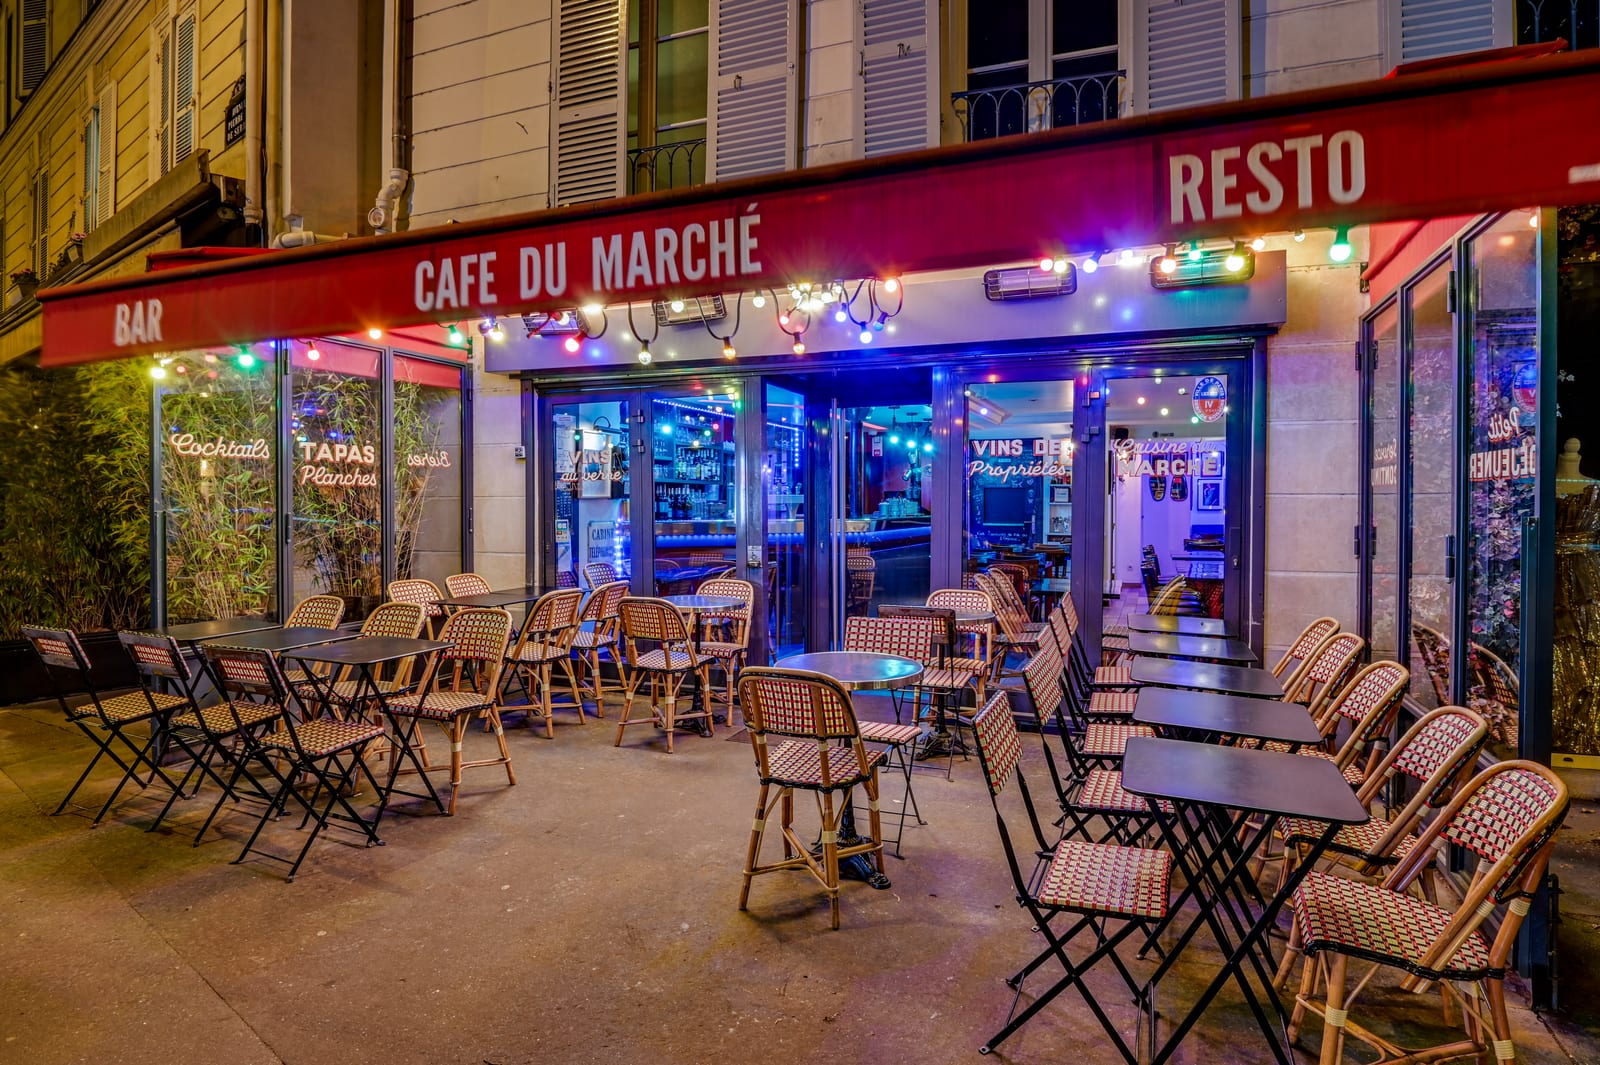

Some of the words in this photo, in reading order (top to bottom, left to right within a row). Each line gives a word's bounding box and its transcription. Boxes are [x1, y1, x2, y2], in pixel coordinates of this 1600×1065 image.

[1168, 129, 1367, 225] RESTO
[414, 251, 498, 312] CAFE
[520, 241, 567, 301] DU
[591, 202, 763, 292] MARCHÉ
[114, 298, 164, 347] BAR
[1204, 400, 1214, 409] IV
[169, 433, 271, 459] Cocktails
[301, 441, 376, 464] TAPAS
[971, 439, 1023, 457] VINS
[1112, 438, 1187, 456] Cuisine
[567, 450, 611, 465] VINS
[300, 465, 378, 487] Planches
[560, 471, 579, 483] au
[967, 460, 1066, 484] Propriétés
